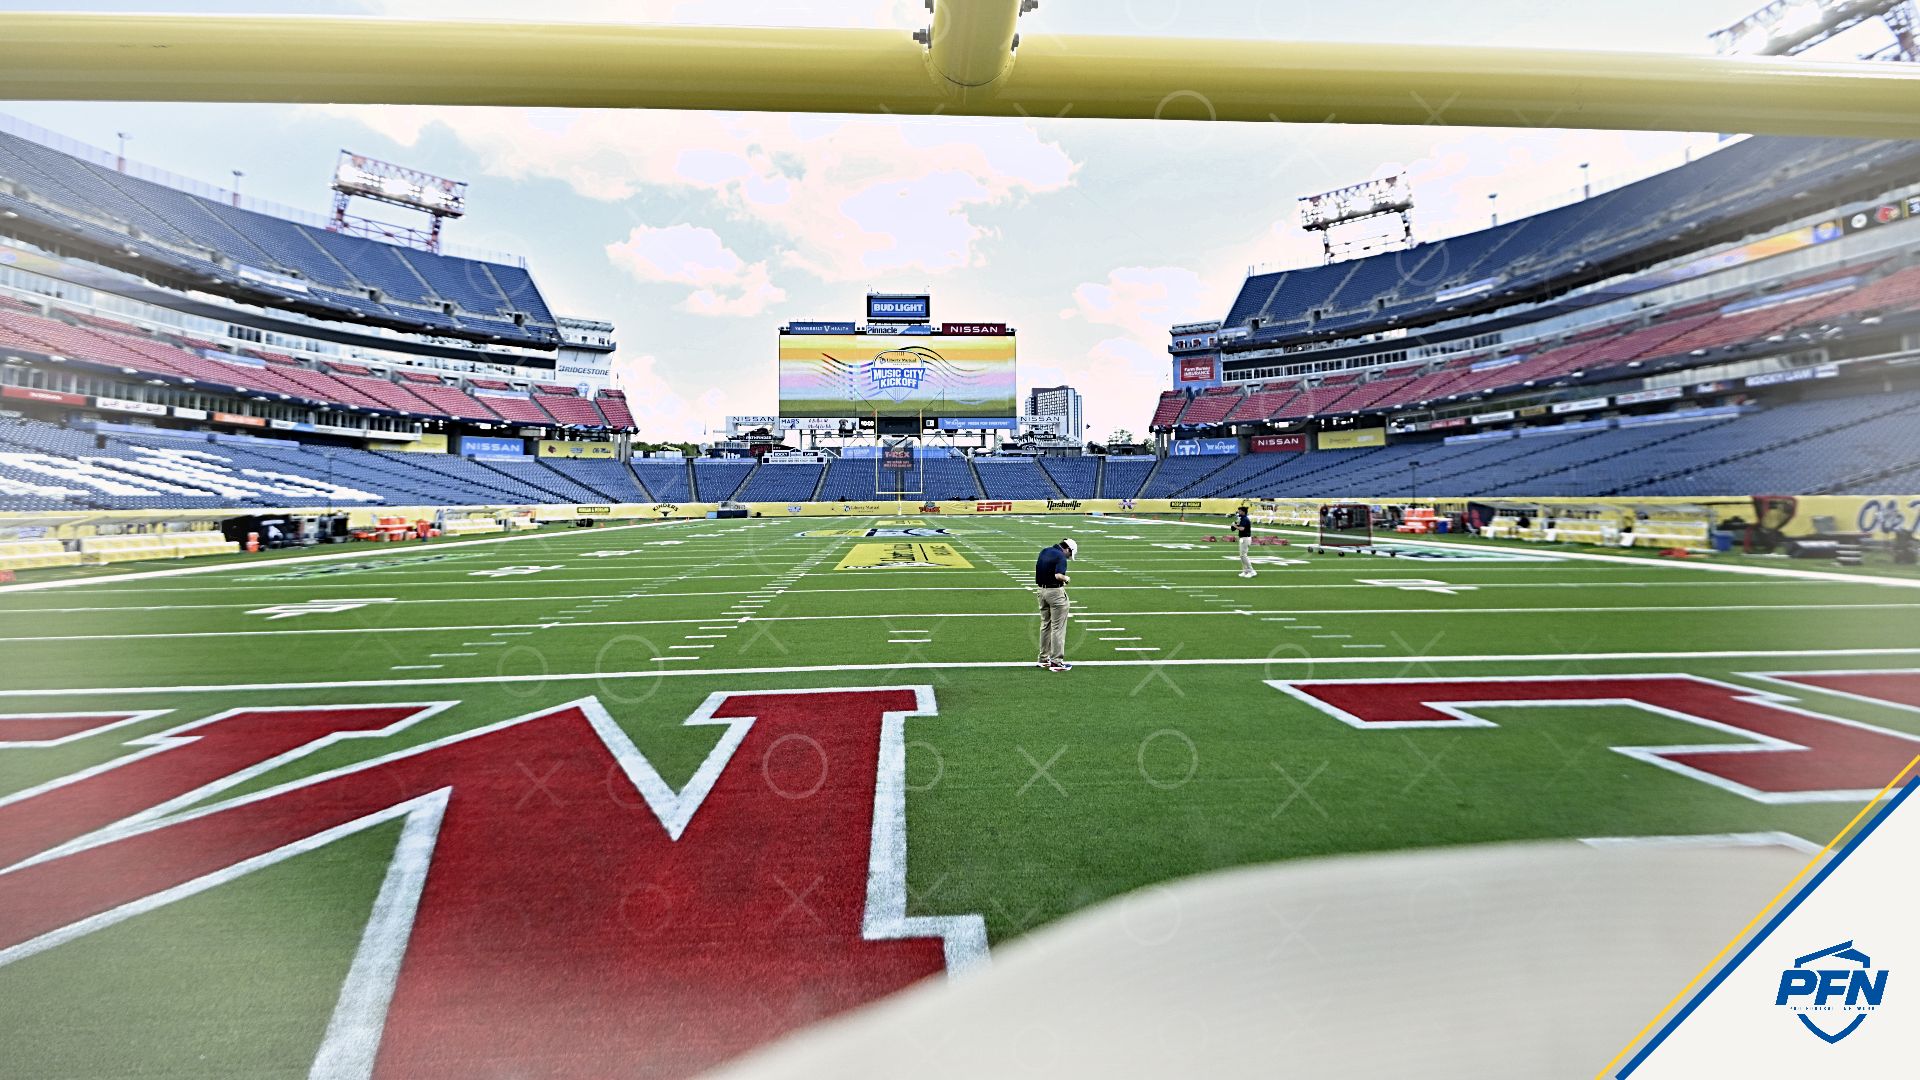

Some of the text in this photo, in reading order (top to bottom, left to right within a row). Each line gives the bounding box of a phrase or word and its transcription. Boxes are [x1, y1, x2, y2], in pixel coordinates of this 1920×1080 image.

[873, 302, 923, 312] BUD LIGHT
[867, 326, 898, 334] Pinnacle
[950, 325, 998, 333] NISSAN
[558, 365, 609, 376] BRIDGESTONE
[873, 369, 924, 380] MUSIC CITY
[880, 378, 917, 388] KICKOFF
[465, 441, 520, 452] NISSAN
[1205, 441, 1237, 452] Kroger
[1257, 437, 1299, 446] NISSAN
[976, 502, 1013, 512] ESPN
[1046, 500, 1082, 511] Nashville
